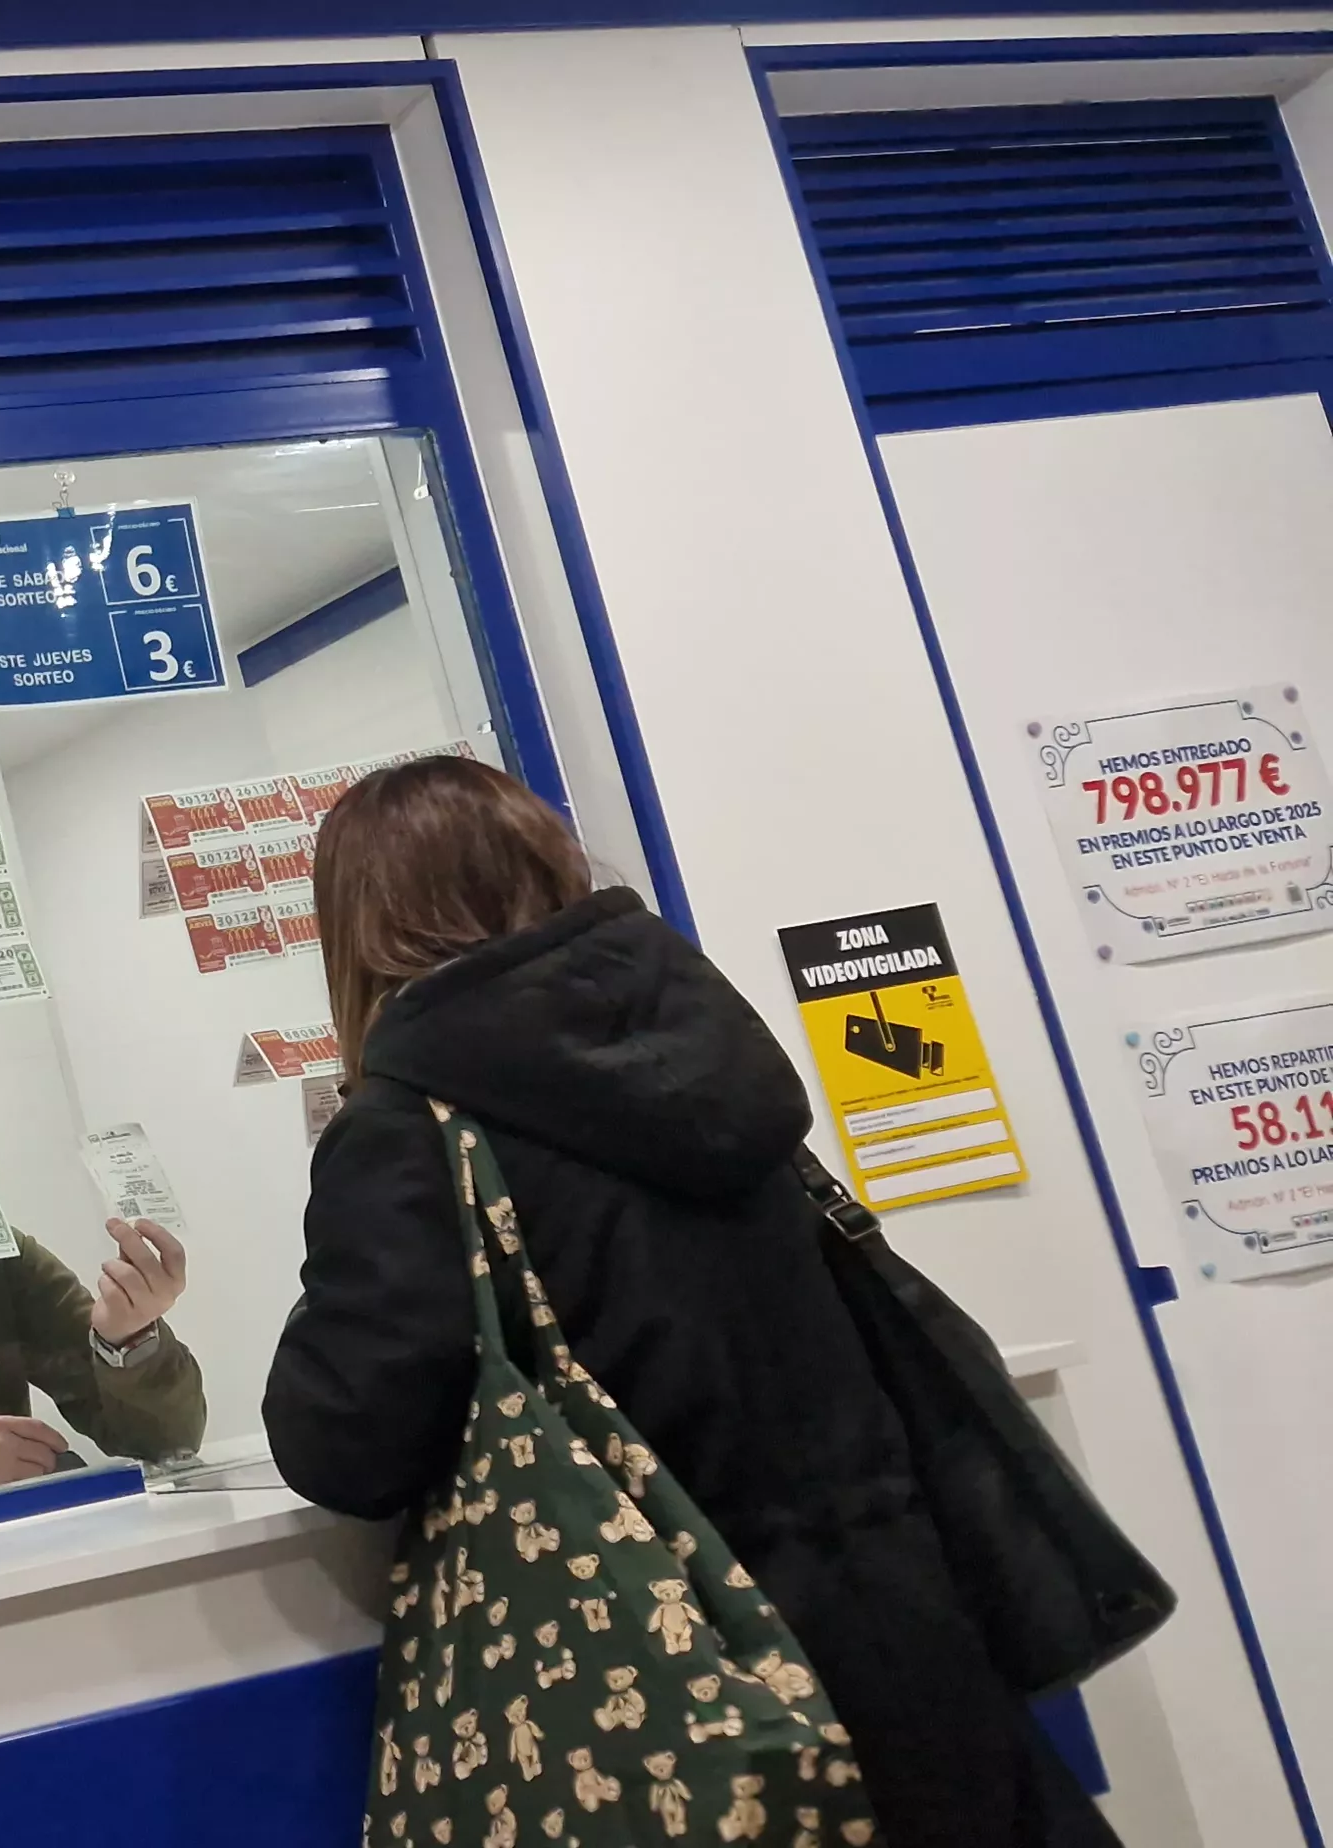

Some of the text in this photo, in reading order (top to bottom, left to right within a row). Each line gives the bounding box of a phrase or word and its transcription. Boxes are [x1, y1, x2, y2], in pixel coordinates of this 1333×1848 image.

[126, 545, 179, 596] 6 €
[33, 648, 93, 667] JUEVES
[143, 630, 196, 682] 3 €
[13, 670, 75, 687] SORTEO
[1098, 738, 1252, 775] HEMOS ENTREGADO
[1081, 752, 1291, 825] 798.977 €
[1077, 800, 1322, 855] EN PREMIOS A LO LARGO DE 2025
[1110, 823, 1308, 871] EN ESTE PUNTO DE VENTA
[836, 924, 890, 952] ZONA
[800, 945, 943, 989] VIDEOVIGILADA
[1189, 1067, 1331, 1105] EN ESTE PUNTO DE
[1208, 1055, 1270, 1081] HEMOS
[1191, 1156, 1270, 1186] PREMIOS
[1272, 1153, 1286, 1171] A
[1285, 1149, 1308, 1168] LO
